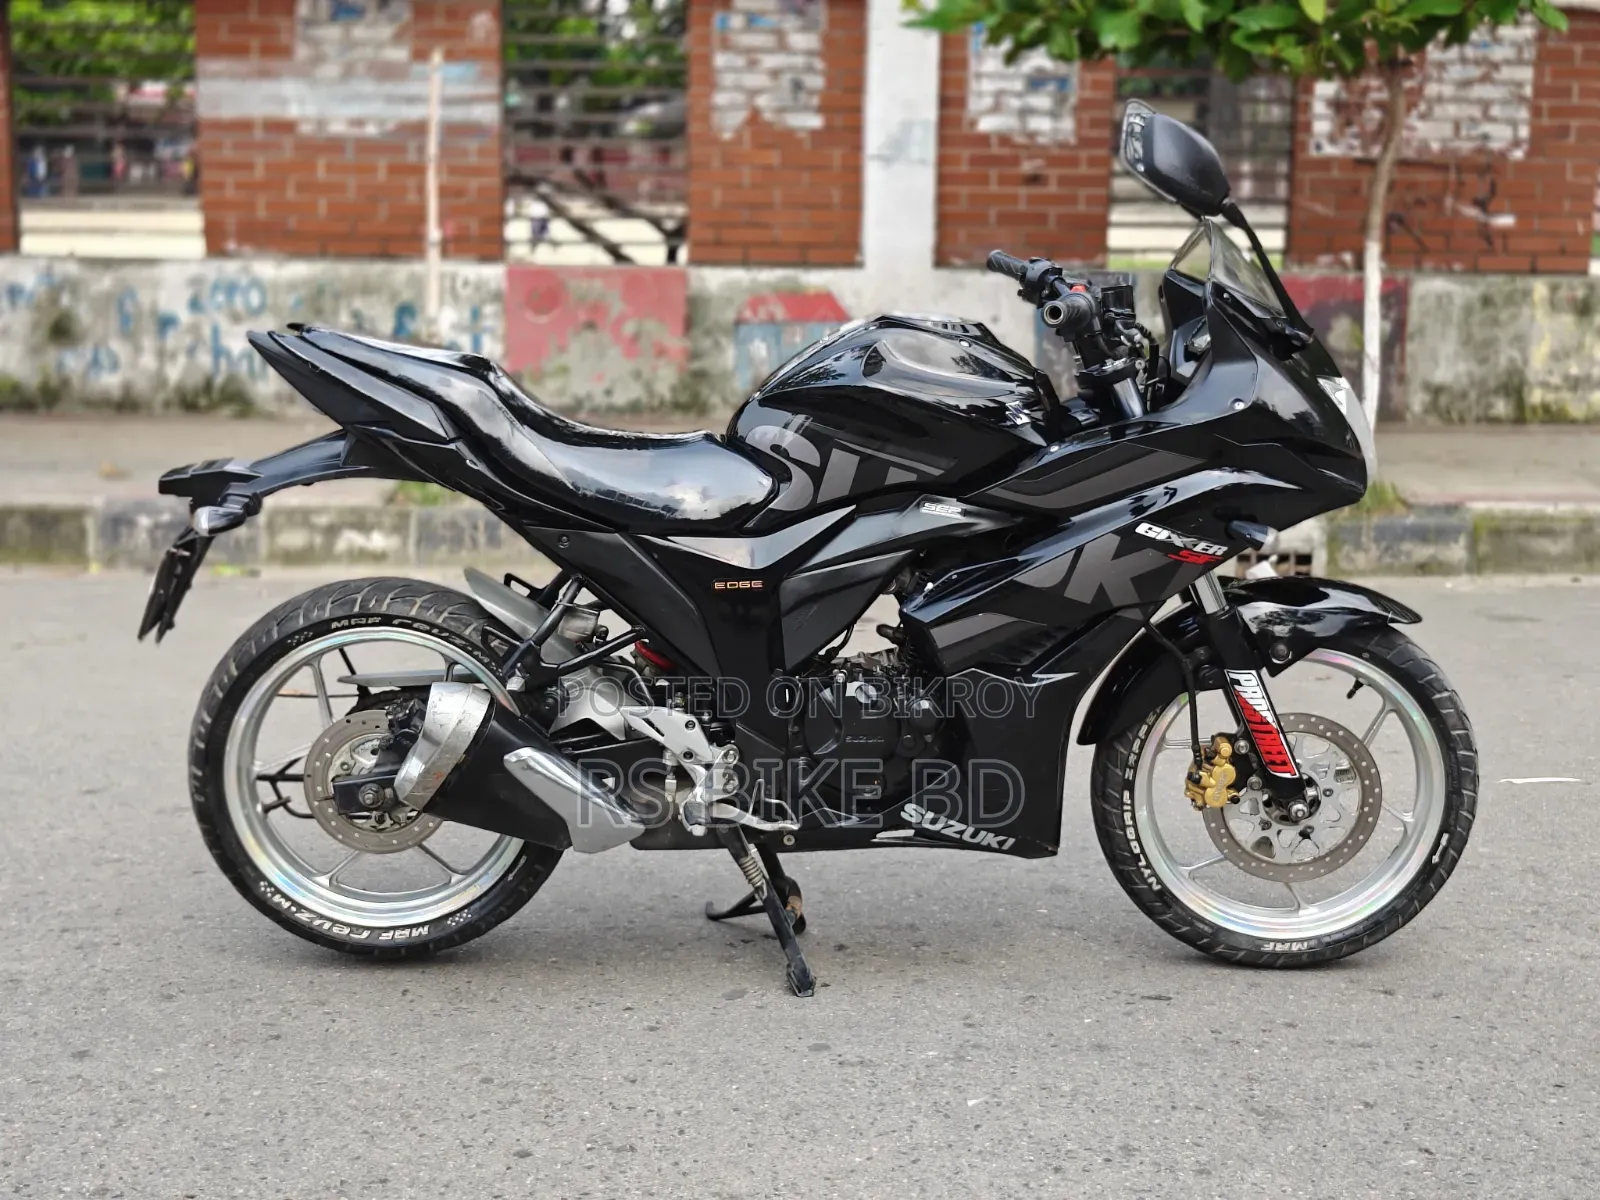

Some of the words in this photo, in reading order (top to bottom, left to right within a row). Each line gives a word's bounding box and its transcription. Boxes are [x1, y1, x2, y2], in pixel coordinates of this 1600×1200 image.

[714, 580, 764, 589] EDGE
[900, 803, 1016, 850] SUZUKI
[1122, 790, 1162, 892] NYLOGRIP
[378, 925, 430, 940] MRF
[1260, 941, 1308, 952] MRF
